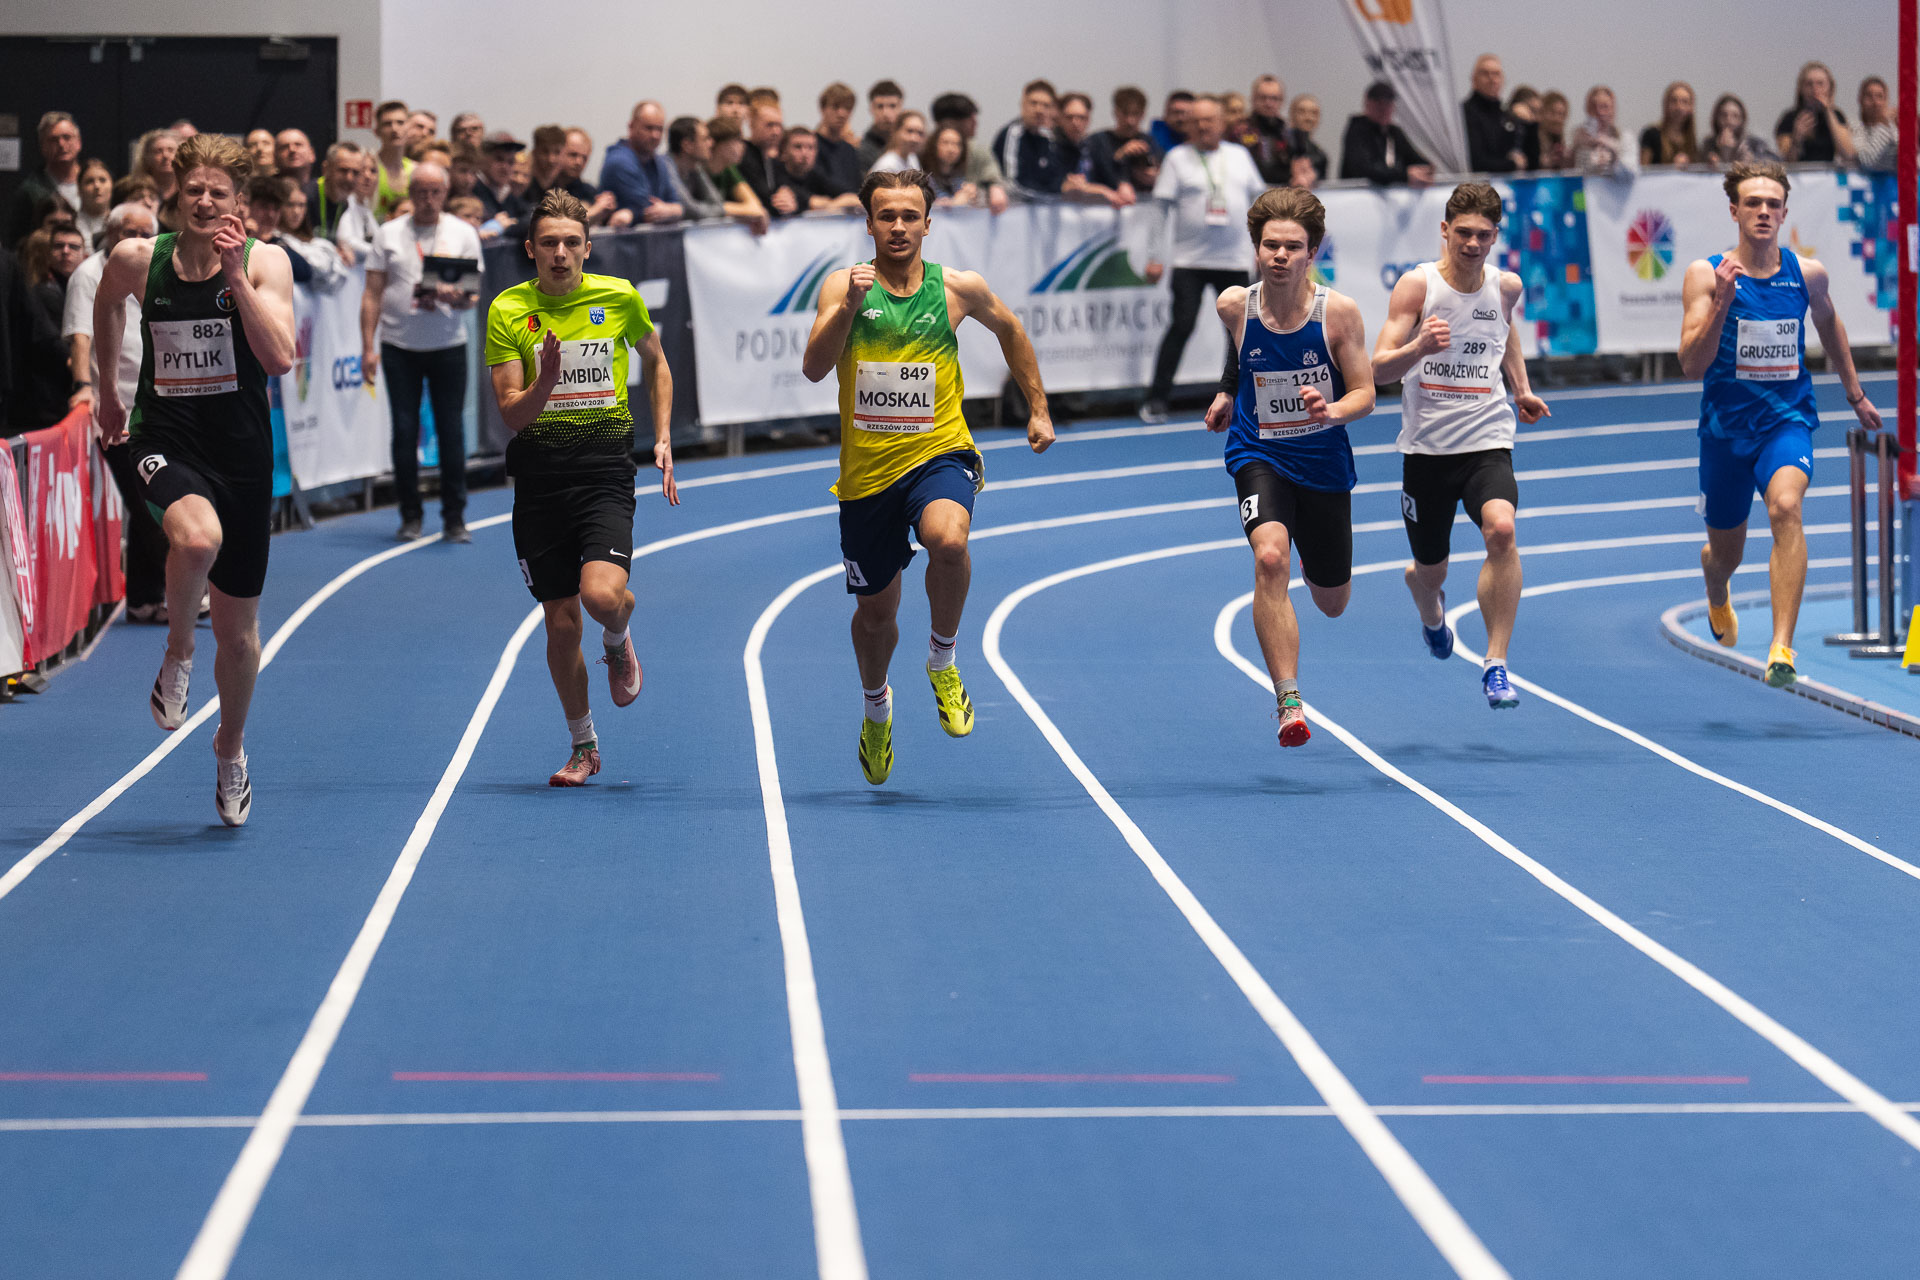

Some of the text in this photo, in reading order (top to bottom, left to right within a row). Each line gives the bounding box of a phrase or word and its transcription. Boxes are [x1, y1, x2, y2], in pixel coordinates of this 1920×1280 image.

[862, 308, 883, 320] 4F
[193, 323, 224, 339] 882
[1776, 322, 1796, 335] 308
[580, 342, 609, 357] 774
[735, 326, 809, 362] PODK
[1462, 342, 1486, 354] 289
[1740, 344, 1797, 359] GRUSZFELD
[163, 350, 223, 369] PYTLIK
[900, 367, 929, 380] 849
[1292, 366, 1329, 387] 1216
[1423, 361, 1489, 381] CHORĄŻEWICZ
[167, 384, 222, 395] RZESZÓW 2026
[1431, 391, 1463, 400] RZESZÓW
[553, 400, 587, 408] RZESZÓW
[859, 390, 931, 408] MOSKAL
[1269, 397, 1305, 414] SIUD
[866, 423, 902, 431] RZESZÓW
[1273, 428, 1307, 437] RZESZÓW
[143, 456, 160, 476] 6
[1243, 499, 1253, 522] 3
[1404, 496, 1415, 518] 2
[850, 562, 861, 585] 4
